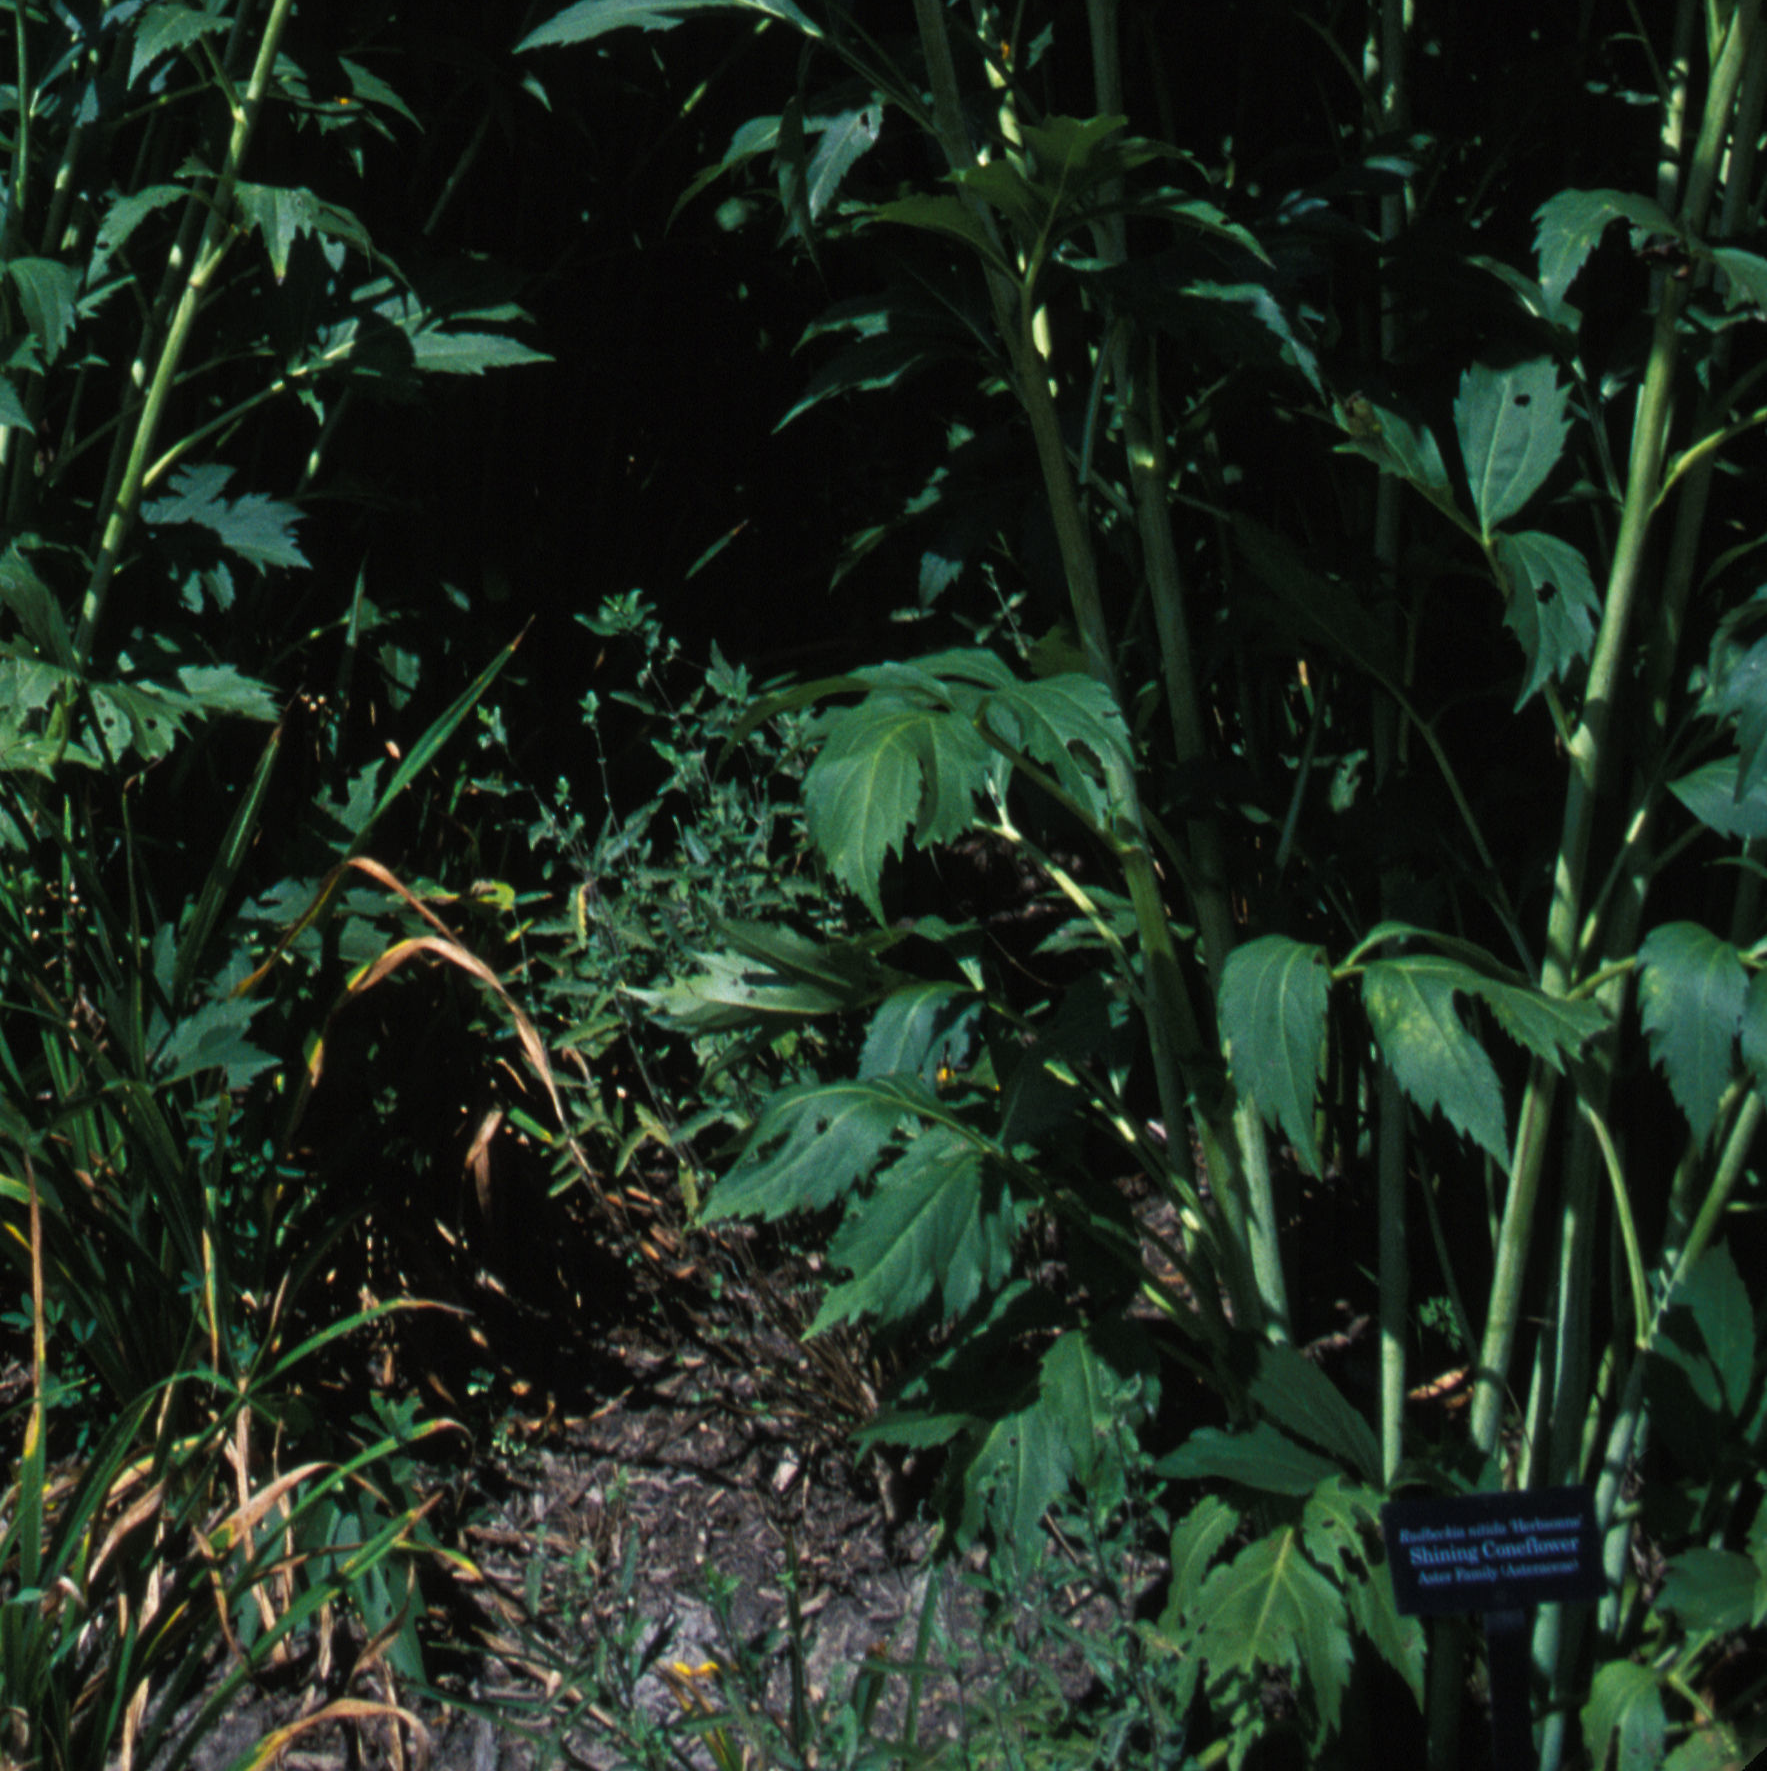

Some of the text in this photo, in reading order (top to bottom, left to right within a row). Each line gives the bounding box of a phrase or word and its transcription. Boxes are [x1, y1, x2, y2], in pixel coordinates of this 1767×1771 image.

[1399, 1525, 1466, 1543] Rudbeckia
[1410, 1536, 1579, 1566] Shining Coneflower
[1419, 1570, 1451, 1585] Aster
[1455, 1565, 1497, 1582] Family
